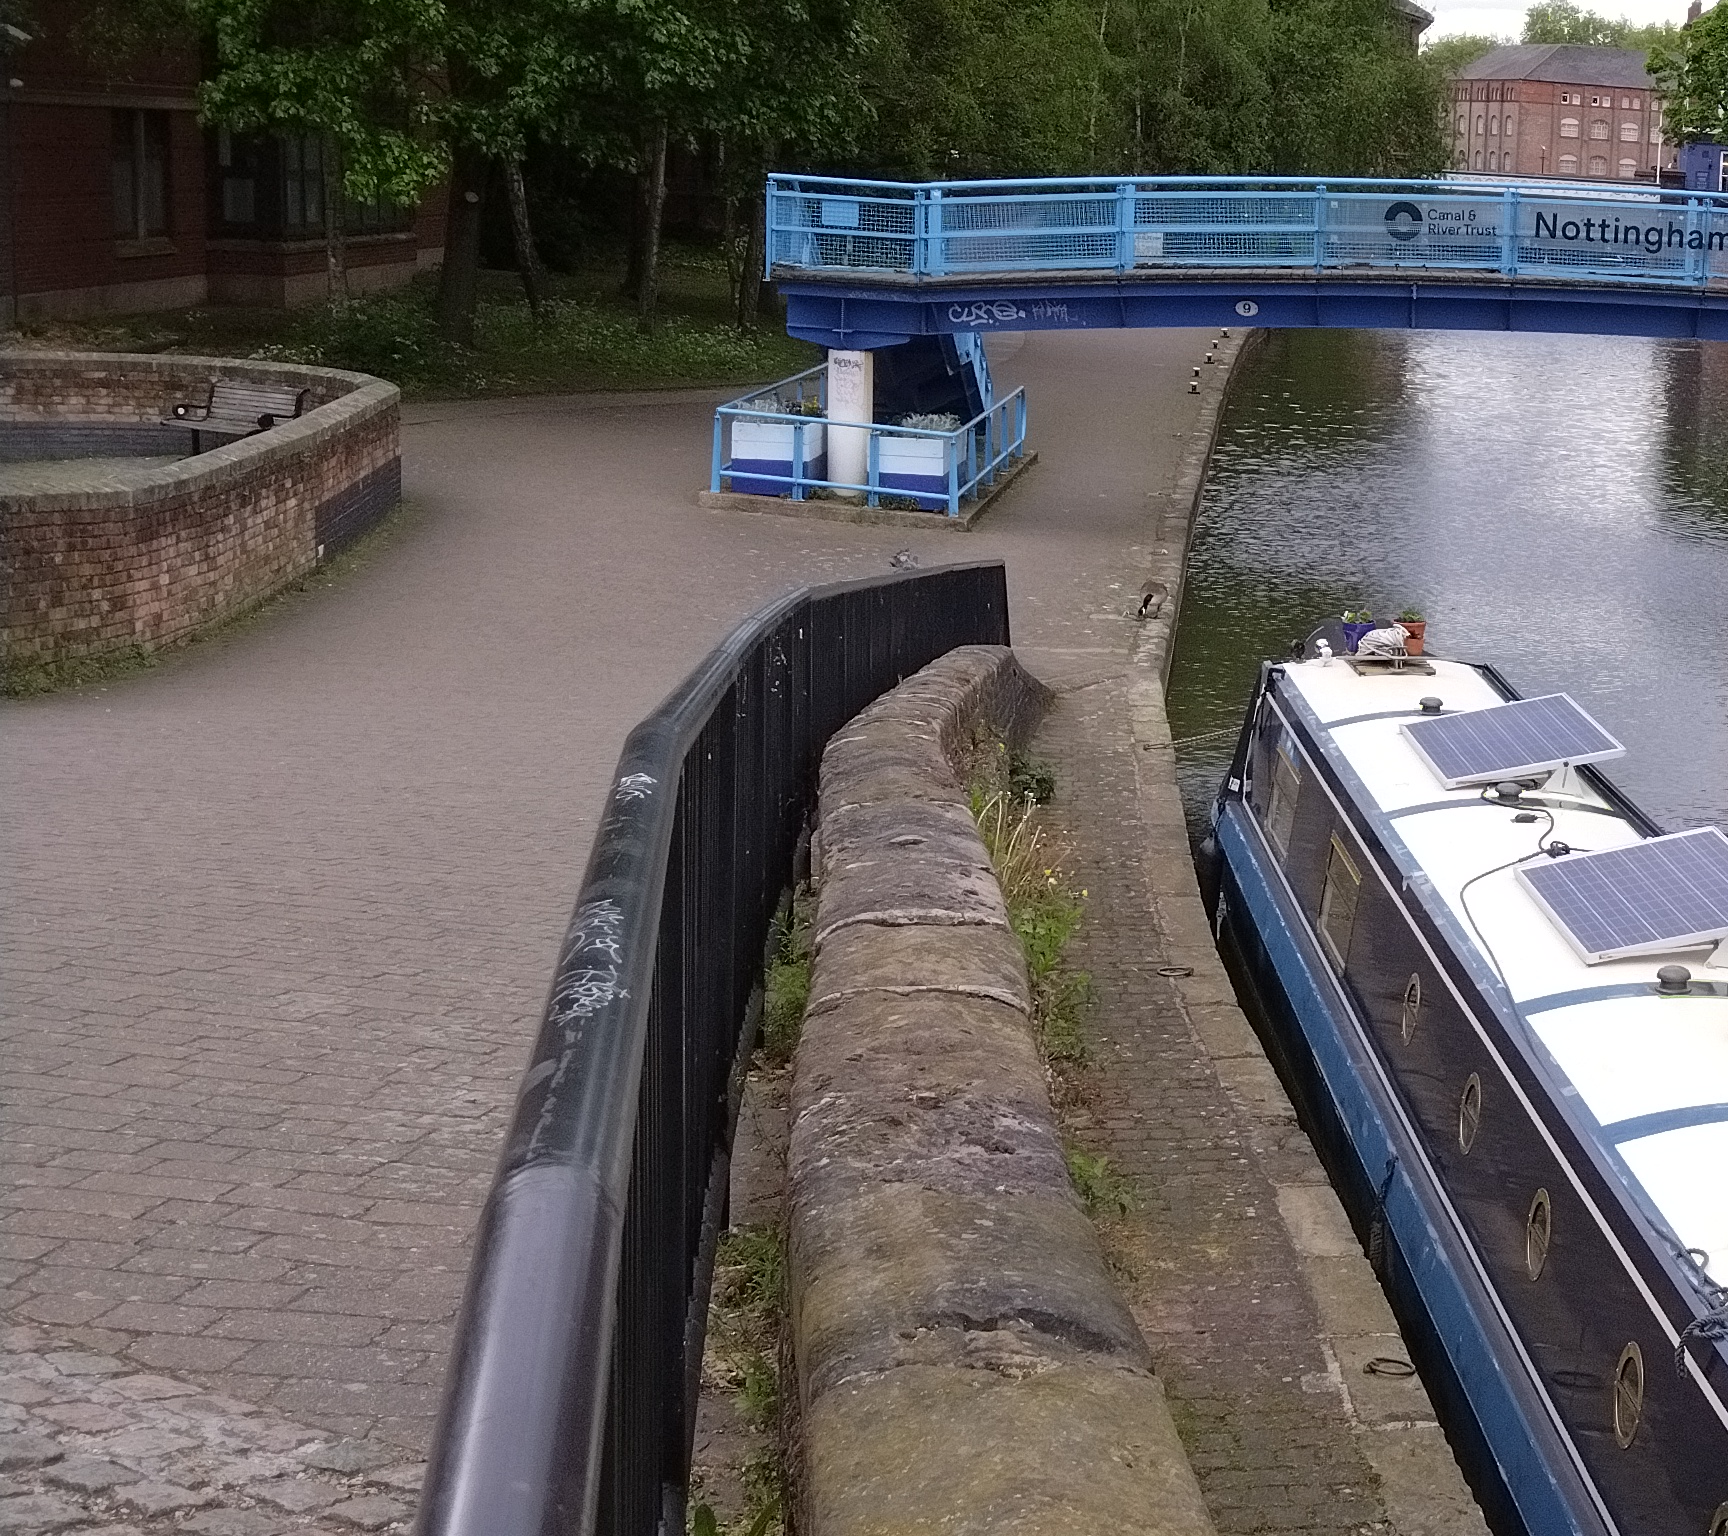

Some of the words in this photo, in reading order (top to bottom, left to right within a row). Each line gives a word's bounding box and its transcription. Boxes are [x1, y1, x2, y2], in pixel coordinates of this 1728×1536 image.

[1427, 208, 1466, 221] Canal
[1467, 209, 1477, 221] &
[1427, 223, 1460, 236] River
[1463, 223, 1498, 237] Trust
[1242, 302, 1252, 314] 9
